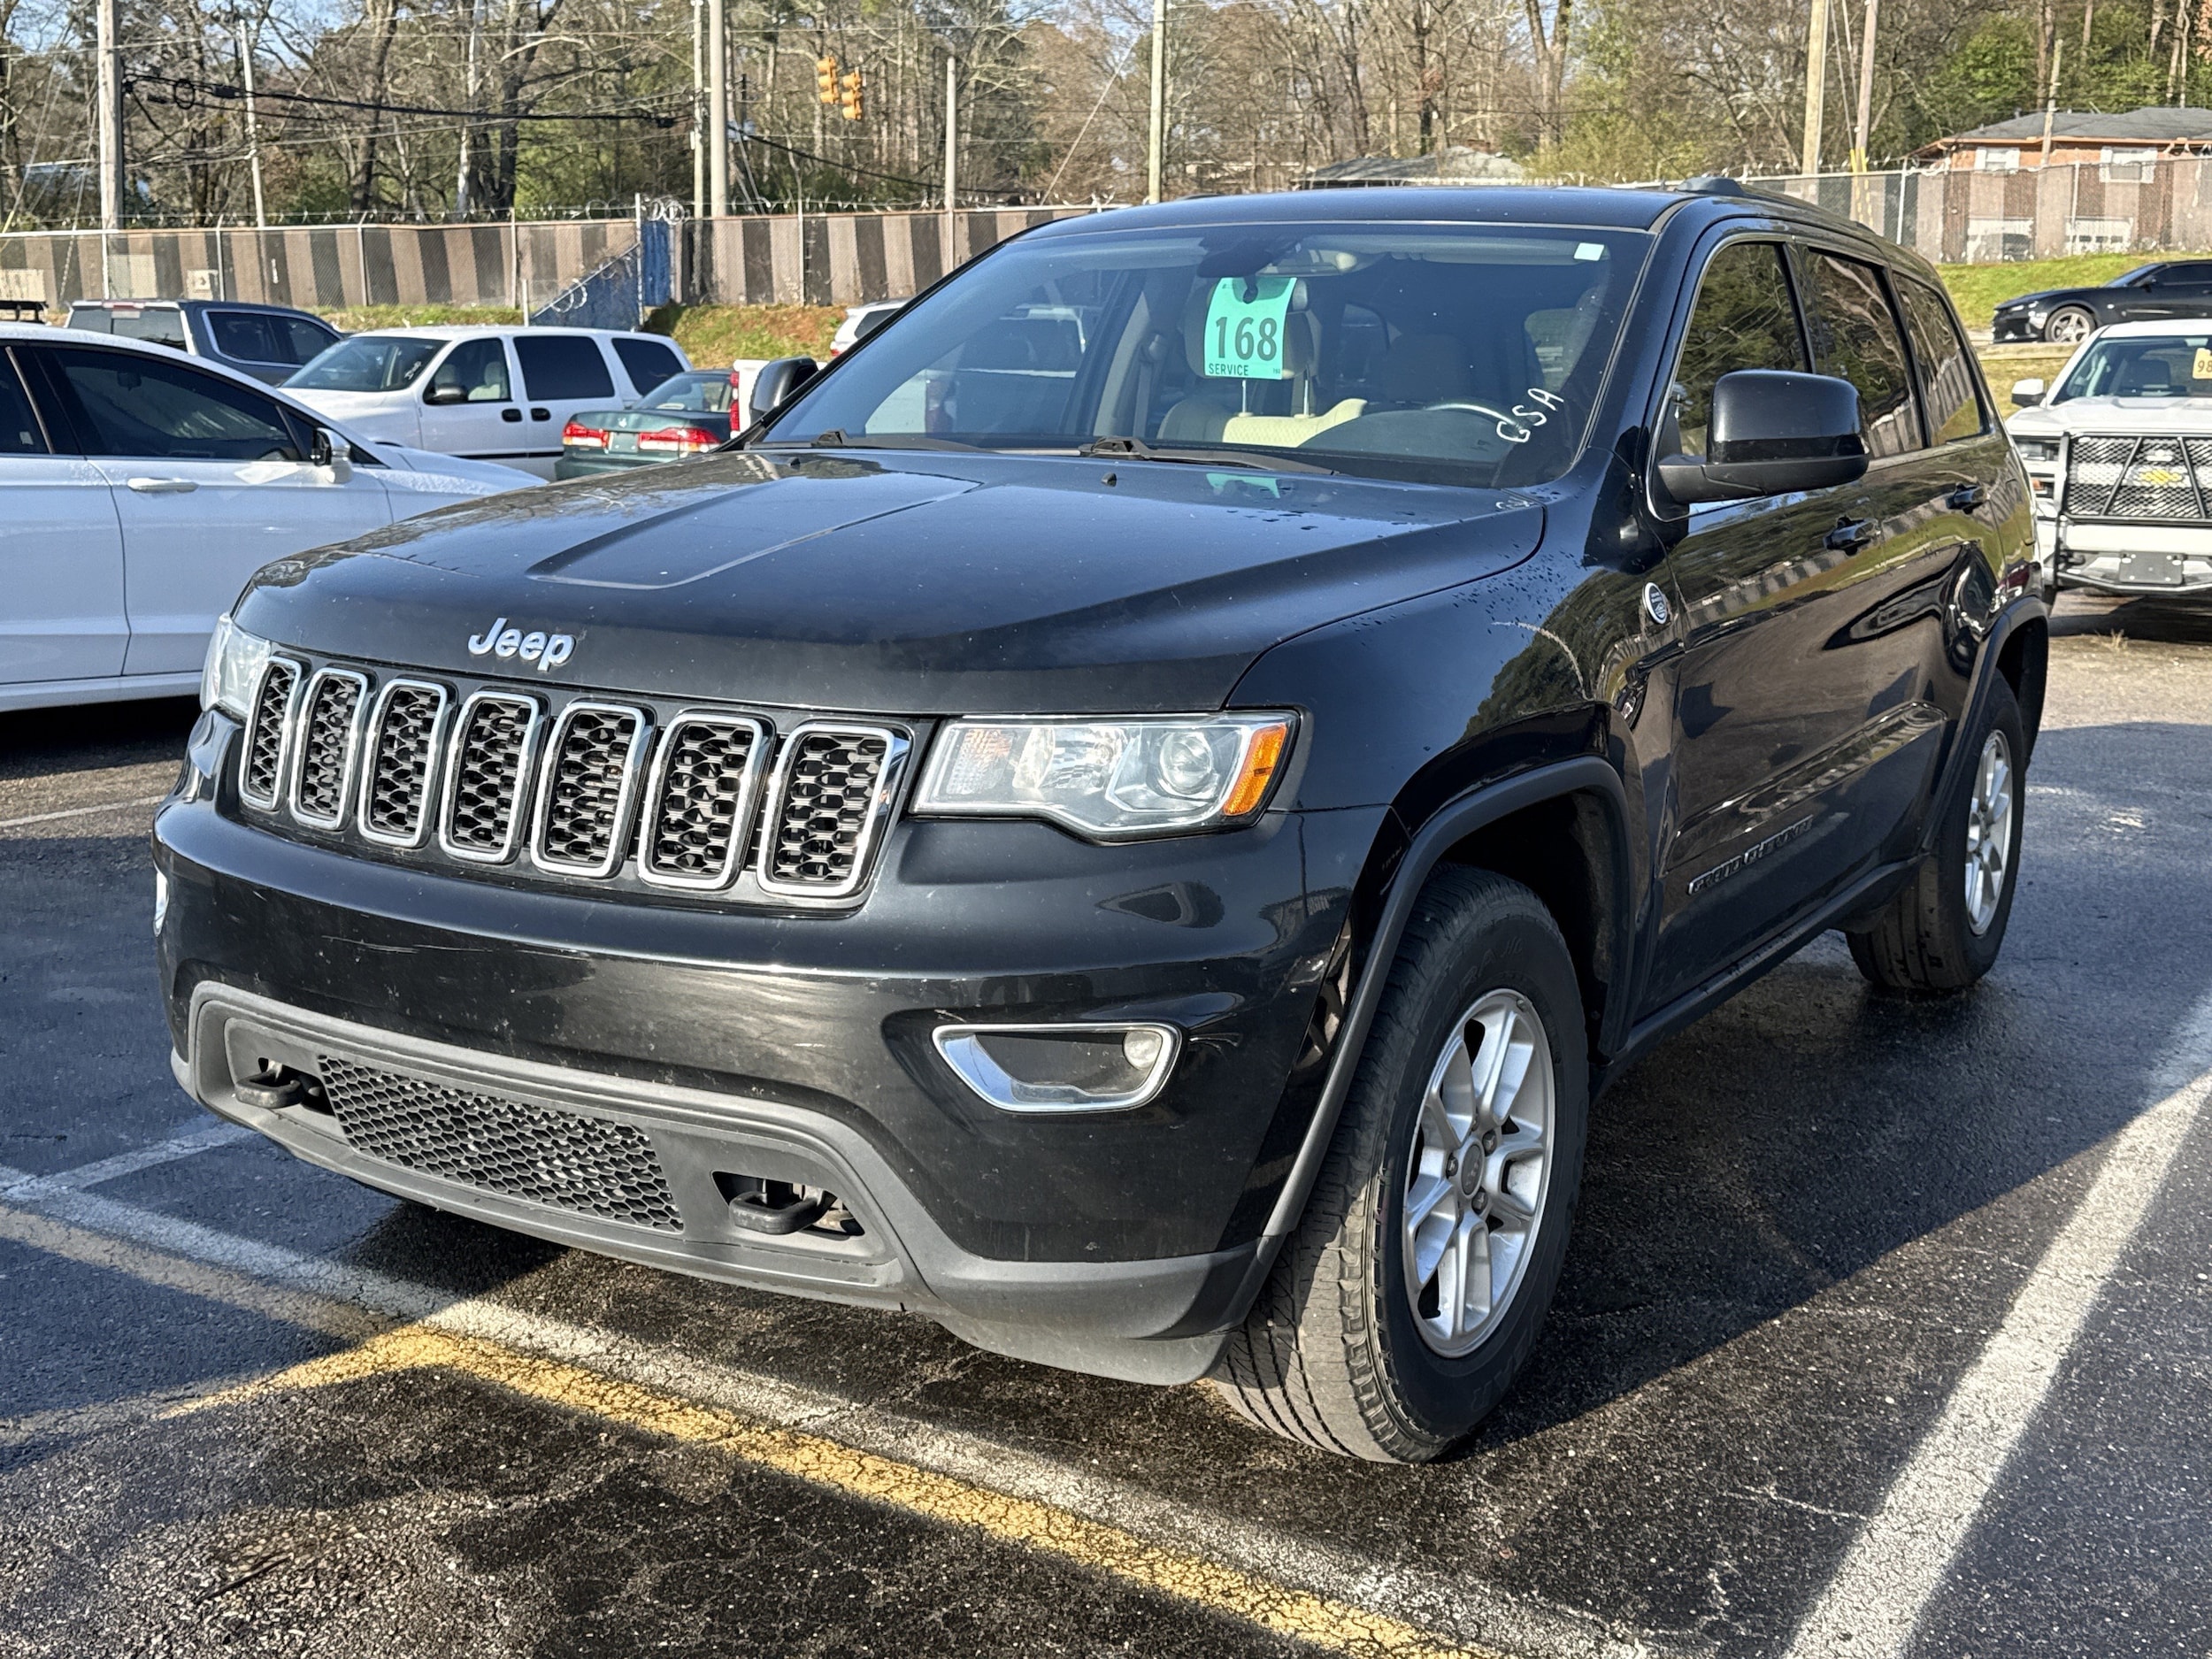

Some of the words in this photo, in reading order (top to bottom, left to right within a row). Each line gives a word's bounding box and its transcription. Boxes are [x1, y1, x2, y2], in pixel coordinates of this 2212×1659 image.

[1216, 317, 1278, 361] 168
[1209, 363, 1249, 376] SERVICE
[1496, 388, 1564, 442] GSA
[468, 617, 576, 672] Jeep
